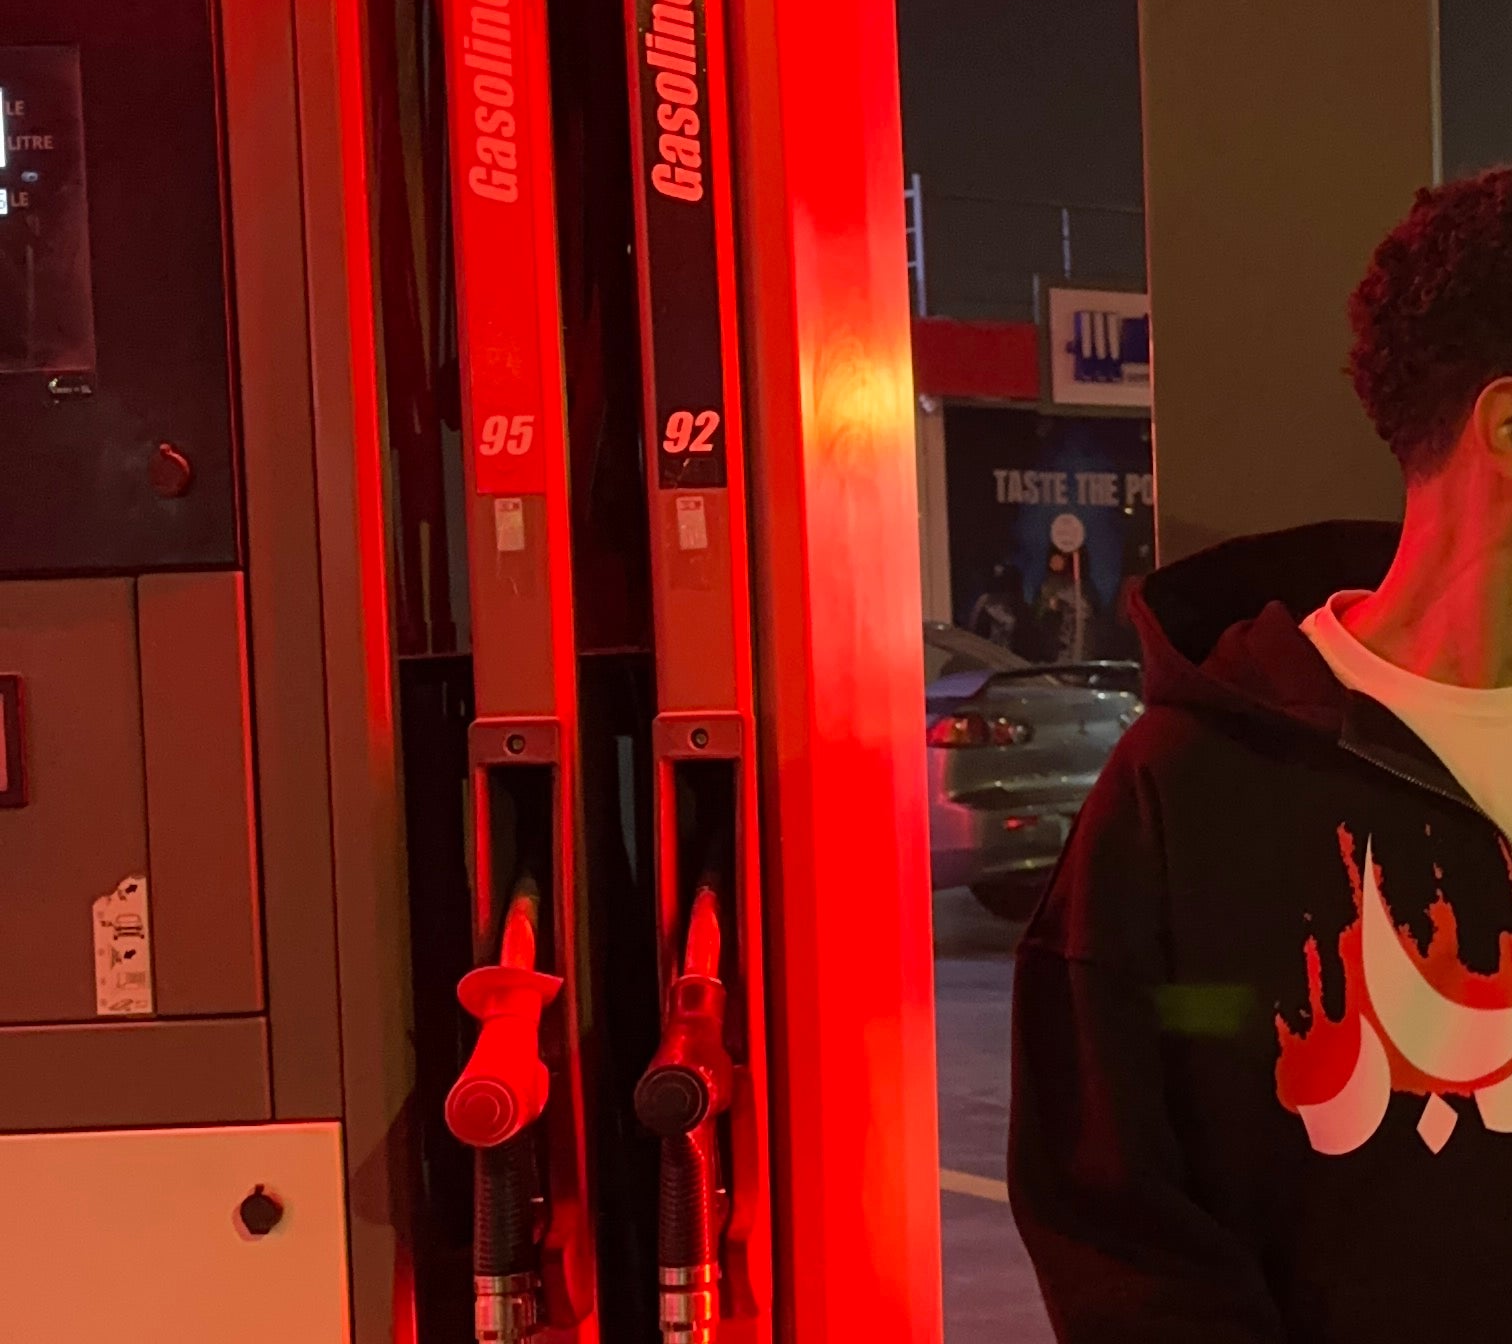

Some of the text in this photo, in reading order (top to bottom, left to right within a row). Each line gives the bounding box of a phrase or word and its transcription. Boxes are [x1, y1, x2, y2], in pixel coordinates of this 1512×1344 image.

[6, 100, 25, 116] LE
[8, 135, 54, 151] LITRE
[11, 192, 29, 207] LE
[479, 415, 535, 456] 95
[662, 410, 720, 454] 92
[993, 468, 1069, 505] TASTE
[1075, 471, 1119, 506] THE
